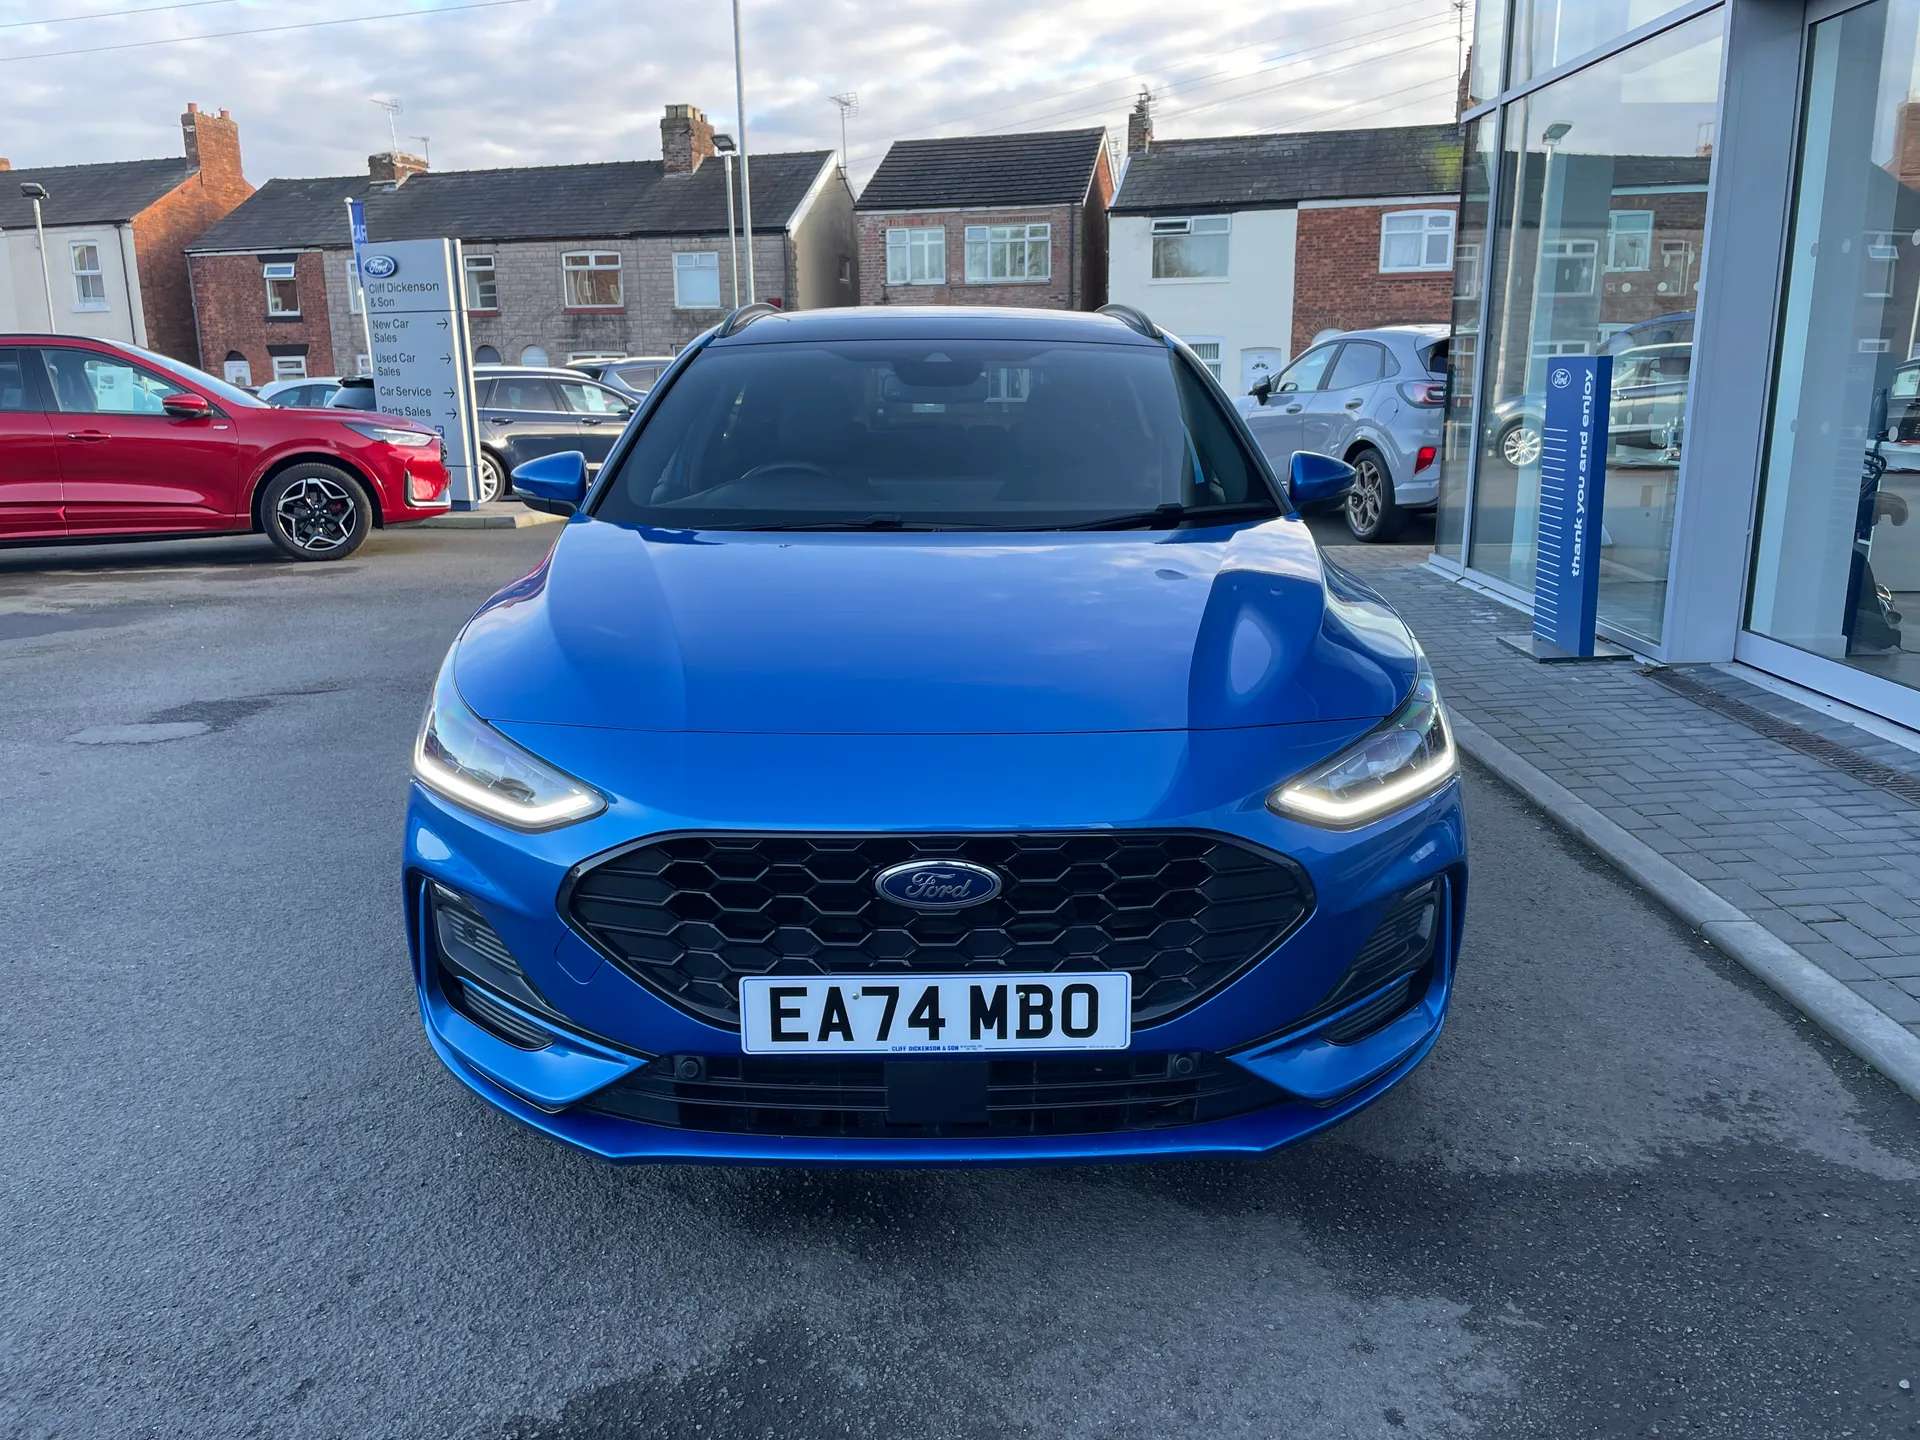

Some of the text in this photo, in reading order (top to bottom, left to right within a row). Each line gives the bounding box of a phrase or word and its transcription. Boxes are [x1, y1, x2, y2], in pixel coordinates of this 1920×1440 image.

[369, 280, 439, 294] Cliff Dickenson
[370, 296, 395, 307] & Son
[372, 318, 409, 329] New Car
[374, 333, 397, 343] Sales
[376, 352, 416, 363] Used Car
[377, 366, 401, 376] Sales
[380, 386, 432, 396] Car Service
[381, 406, 432, 417] Parts Sales
[1571, 369, 1593, 577] thank you and enjoy
[905, 871, 972, 899] Ford
[768, 983, 1099, 1042] EA74 MBO
